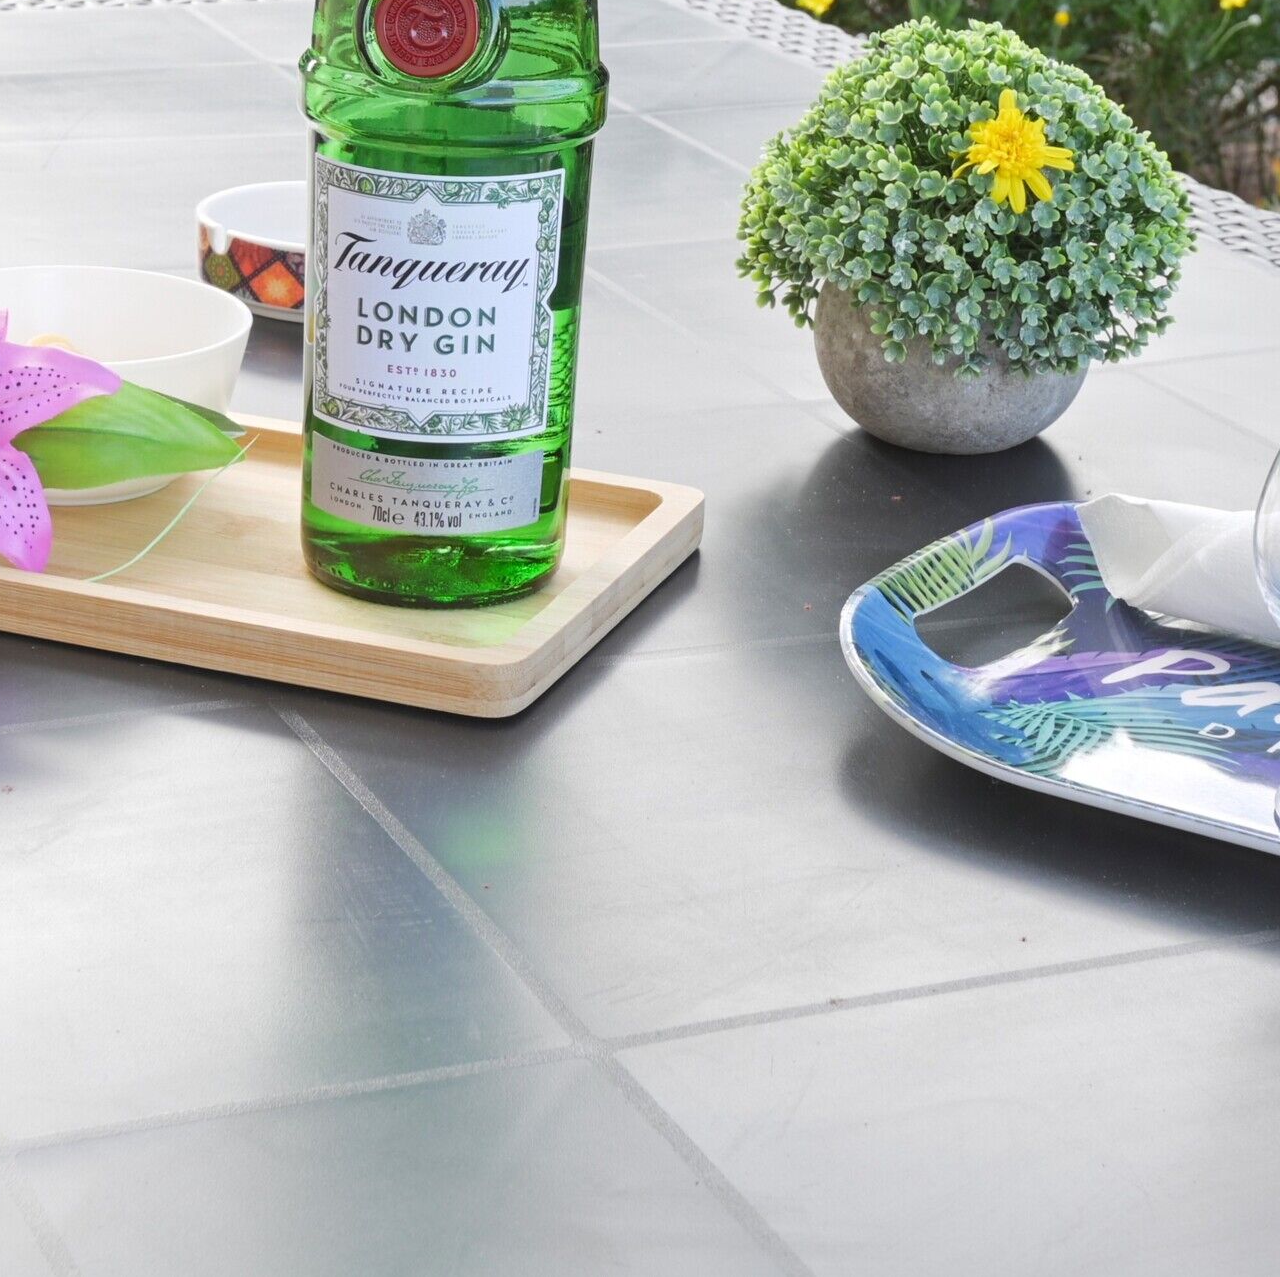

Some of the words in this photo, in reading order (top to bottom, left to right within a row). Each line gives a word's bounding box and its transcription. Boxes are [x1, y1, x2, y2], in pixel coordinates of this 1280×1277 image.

[334, 231, 531, 294] Tanqueray
[357, 297, 497, 328] LONDON
[356, 324, 419, 352] DRY
[433, 333, 496, 356] GIN
[424, 368, 458, 378] 1830
[339, 382, 356, 392] FOUR
[358, 388, 402, 401] PERFECTLY
[405, 396, 451, 405] BALANCED
[454, 394, 513, 405] BOTANICALS
[355, 377, 432, 396] SIGNATURE
[441, 387, 494, 396] RECIPE
[332, 443, 371, 460] PRODUCED
[384, 457, 425, 468] BOTTLED
[478, 458, 513, 468] BRITAIN
[329, 481, 384, 503] CHARLES
[392, 497, 482, 509] TANQUERAY
[487, 498, 495, 507] &
[371, 504, 391, 523] 70cl
[413, 511, 445, 528] 43.1%
[447, 512, 462, 528] vol
